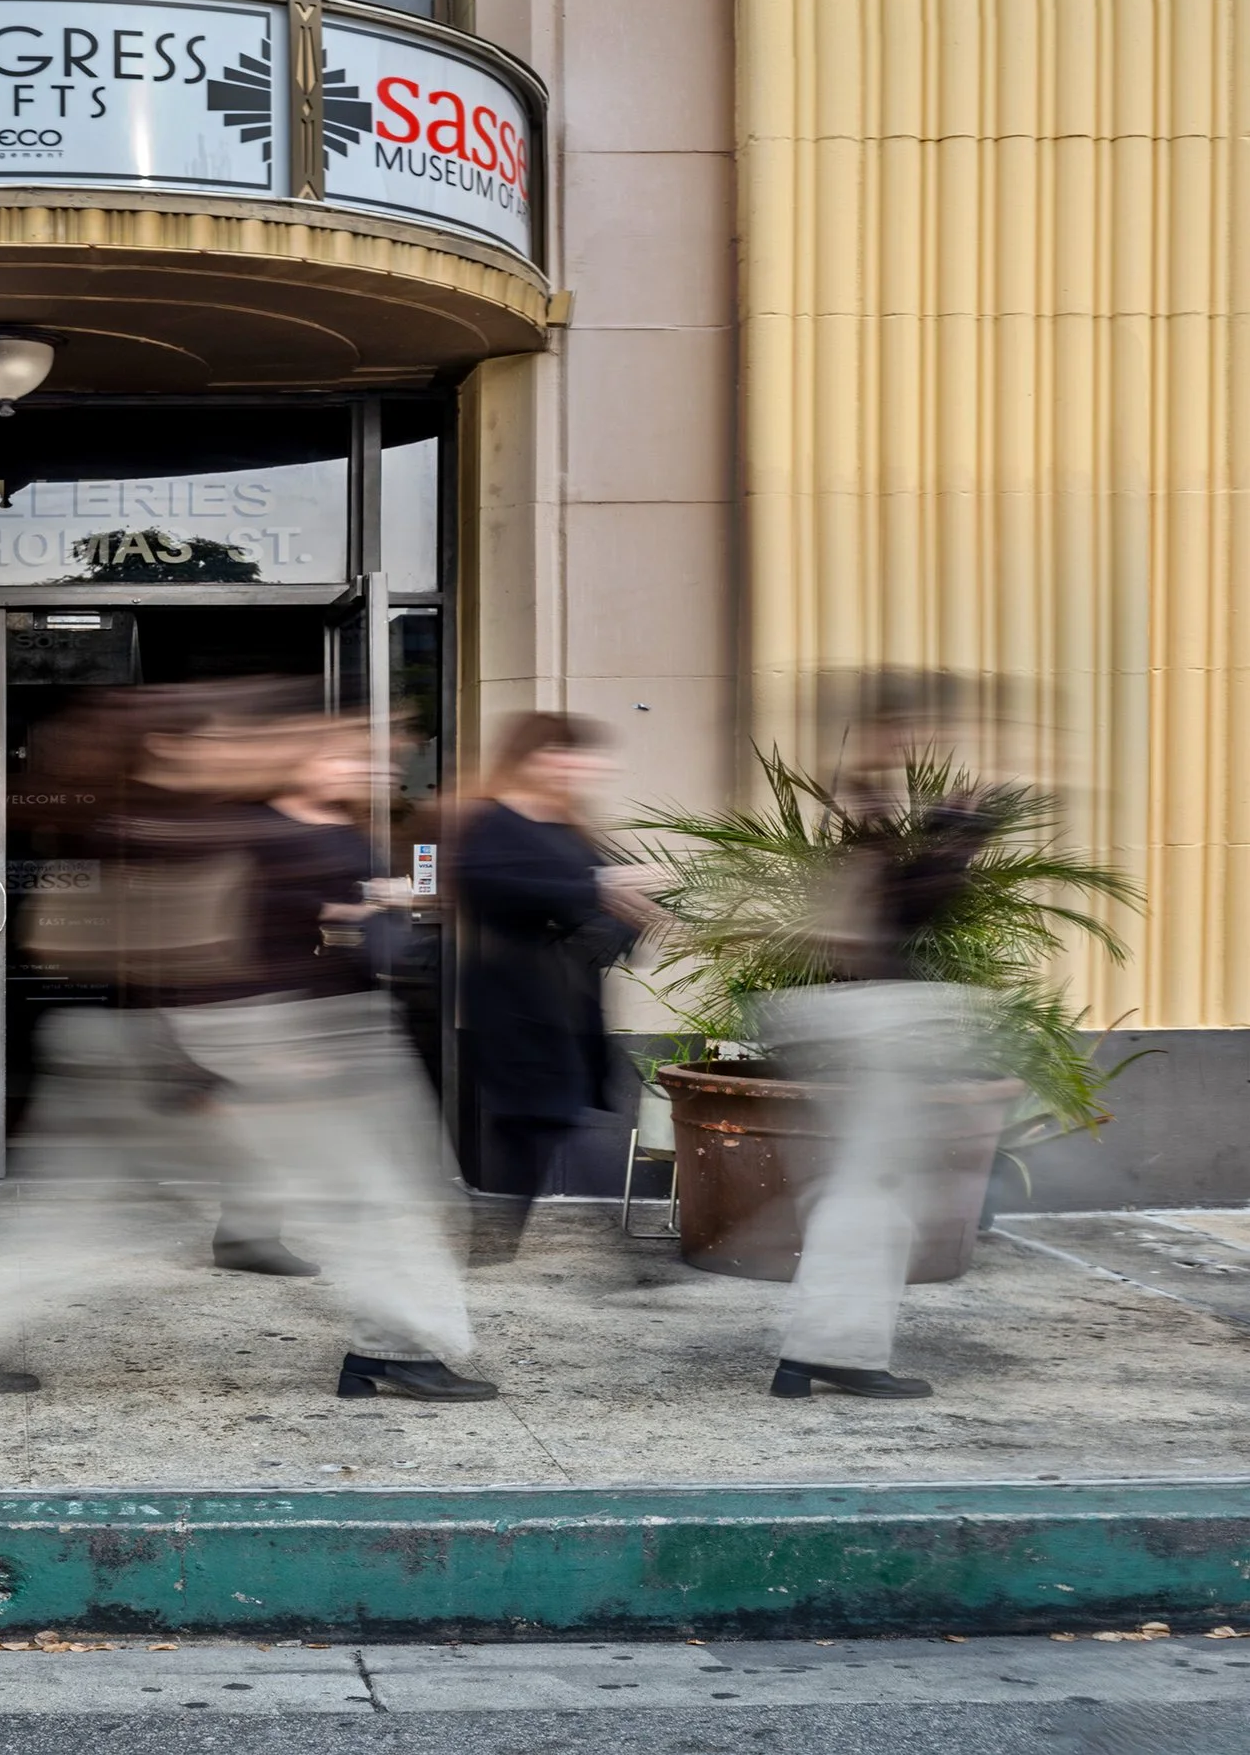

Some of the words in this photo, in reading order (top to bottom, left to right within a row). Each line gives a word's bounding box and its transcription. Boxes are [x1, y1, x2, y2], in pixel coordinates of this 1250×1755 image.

[375, 141, 494, 202] MUSEUM
[227, 526, 313, 565] ST.
[75, 794, 96, 804] TO
[7, 873, 91, 890] sasse
